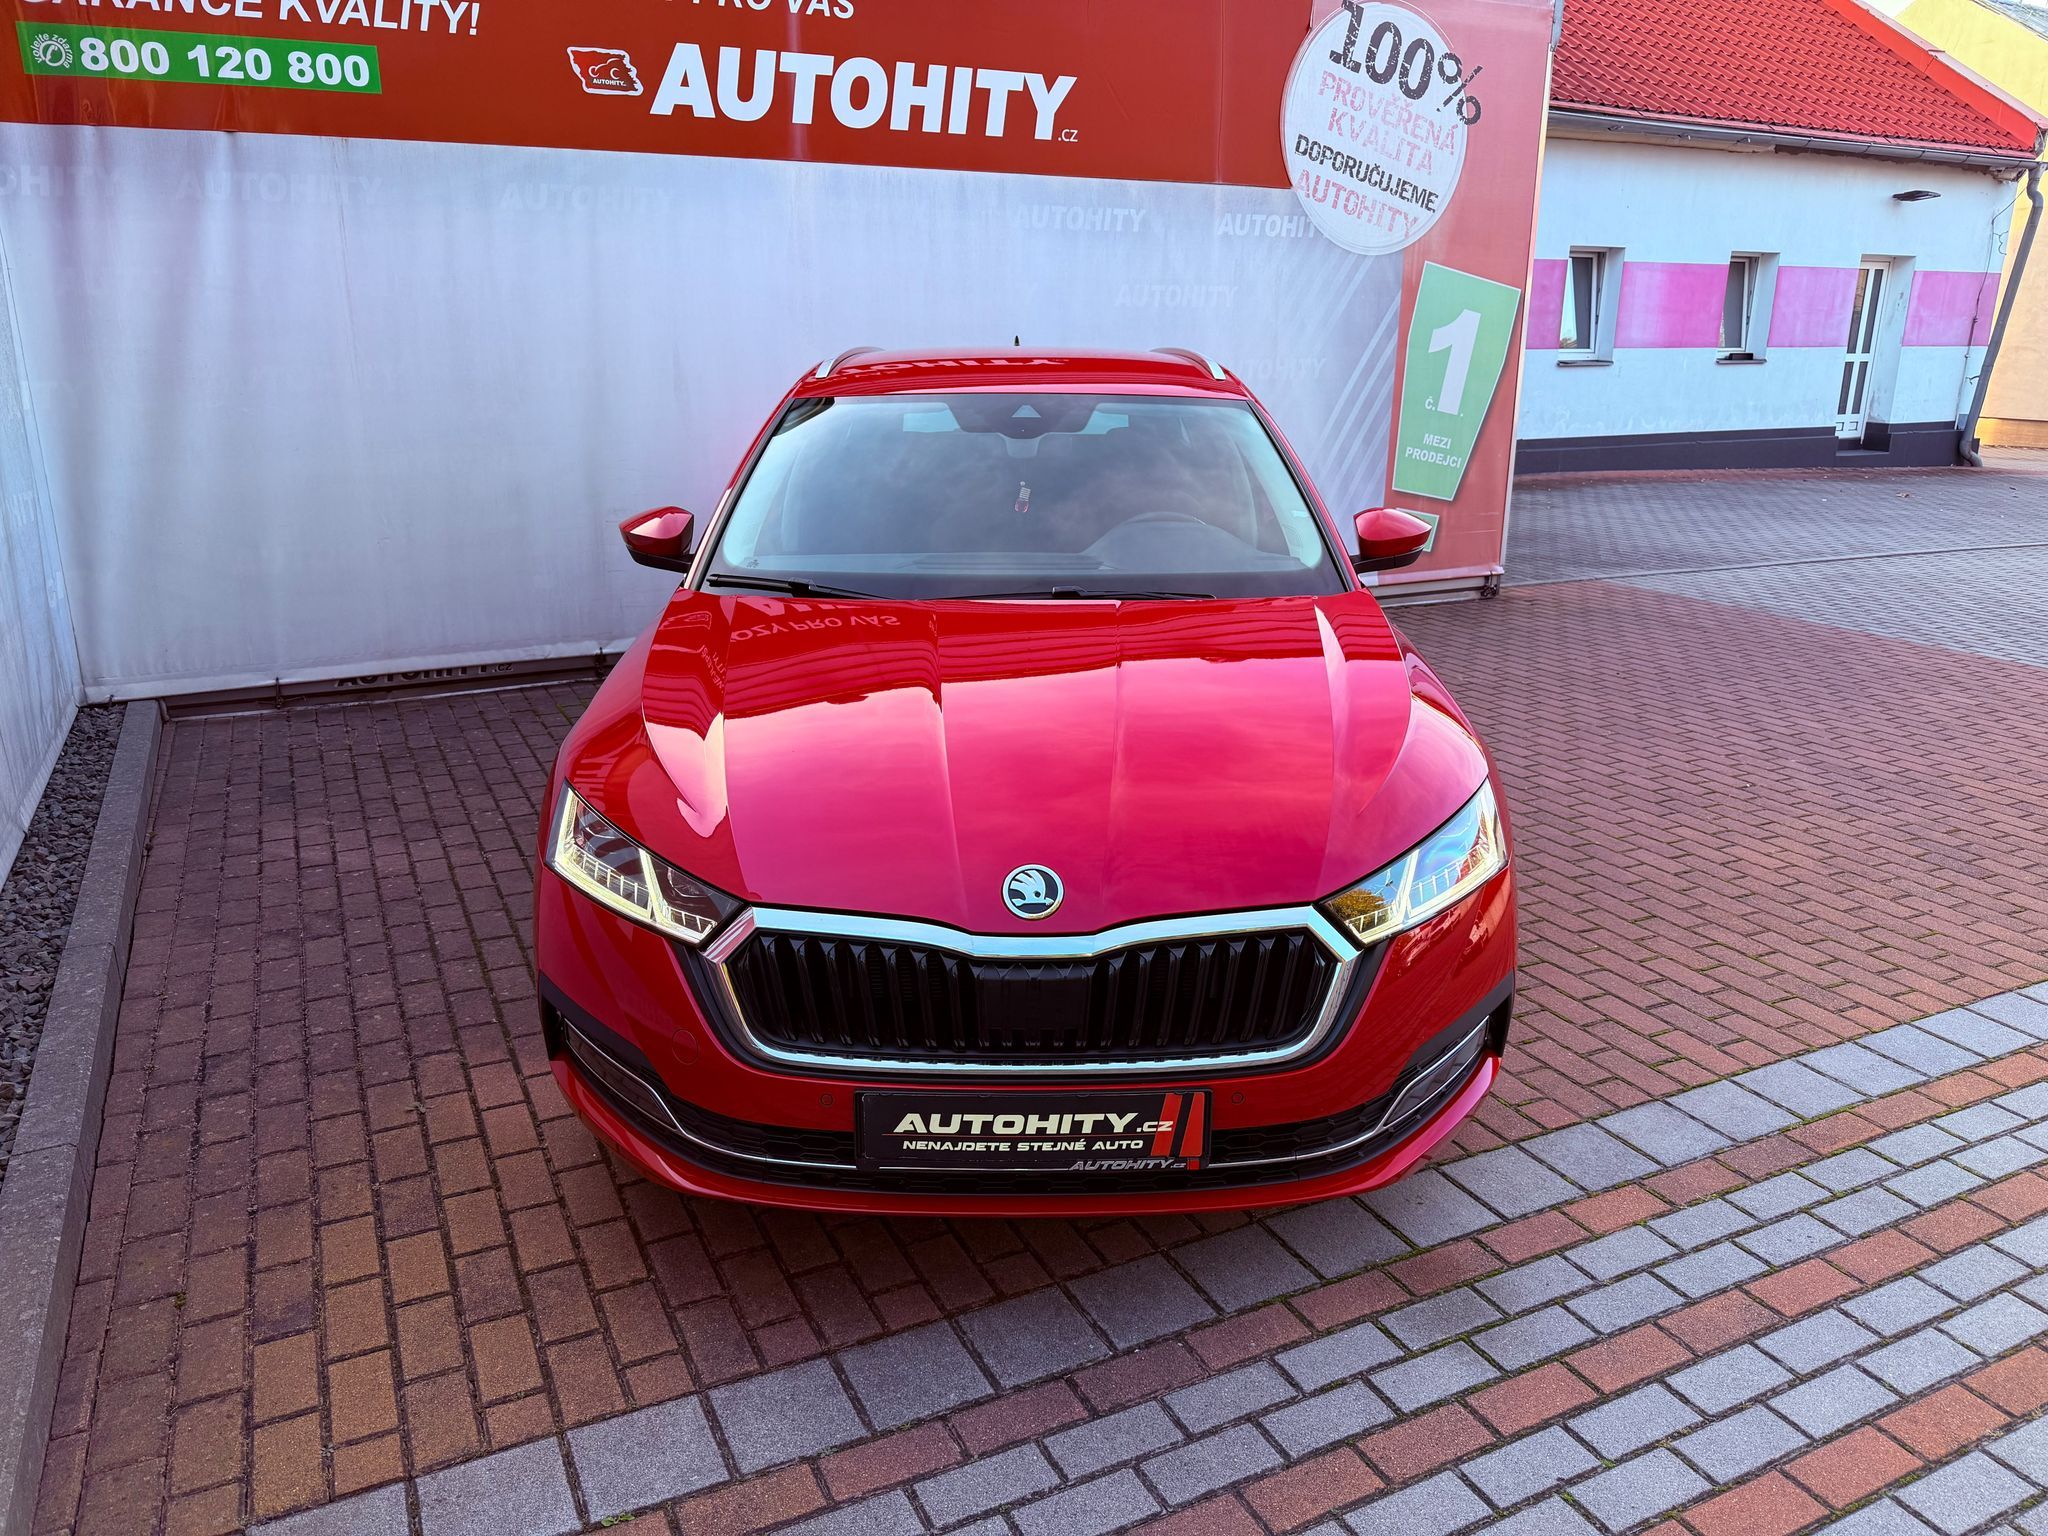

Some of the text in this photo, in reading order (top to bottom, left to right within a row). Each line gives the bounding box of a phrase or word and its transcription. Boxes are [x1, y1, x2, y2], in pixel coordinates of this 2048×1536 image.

[279, 0, 480, 36] KVALITY!
[51, 34, 73, 69] zdarma
[80, 37, 370, 87] 800 120 800
[1329, 0, 1483, 126] 100%
[1318, 70, 1459, 156] PROVĚŘENÁ
[1327, 107, 1433, 176] KVALITA
[1294, 133, 1439, 213] DOPORUČUJEME
[1010, 204, 1147, 233] AUTOHITY
[1296, 169, 1420, 240] AUTOHITY
[1113, 284, 1240, 310] AUTOHITY
[1405, 446, 1462, 468] PRODEJCI
[1423, 433, 1452, 449] MEZI
[903, 1138, 1144, 1153] NENAJDETE STEJNÉ AUTO
